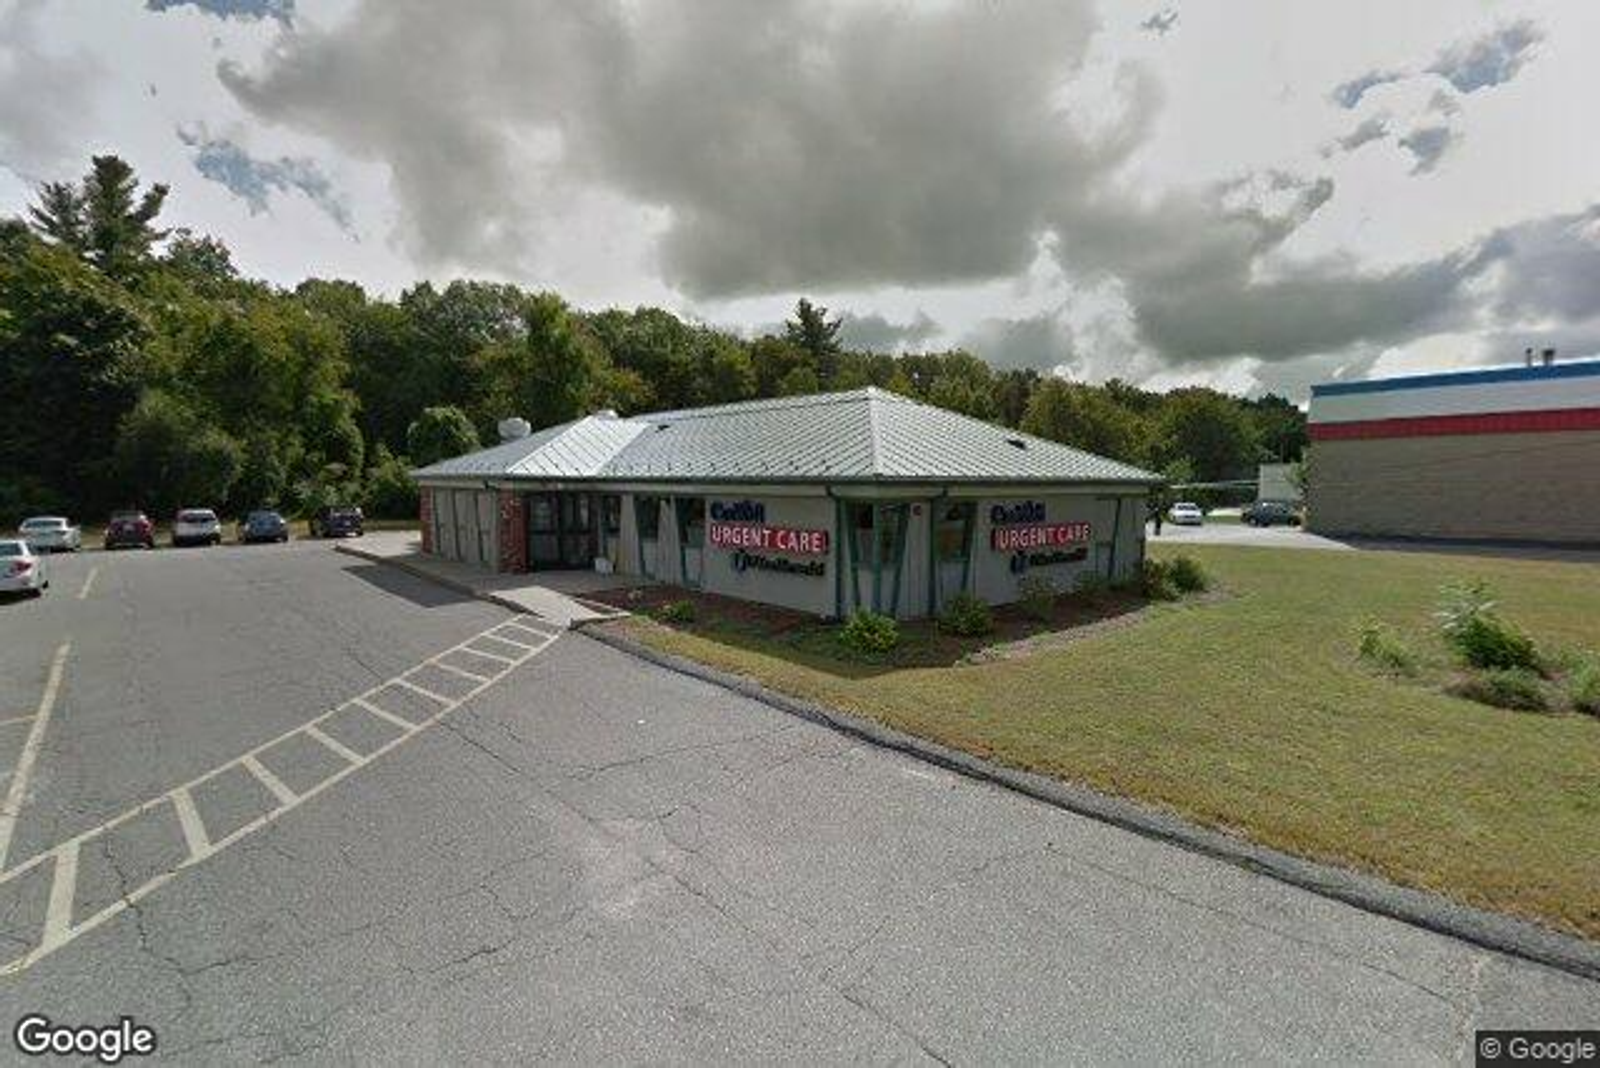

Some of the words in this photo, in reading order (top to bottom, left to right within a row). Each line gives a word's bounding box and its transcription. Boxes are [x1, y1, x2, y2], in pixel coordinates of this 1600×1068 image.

[711, 525, 772, 548] URGENT
[776, 530, 822, 552] CARE
[999, 526, 1055, 549] URGENT
